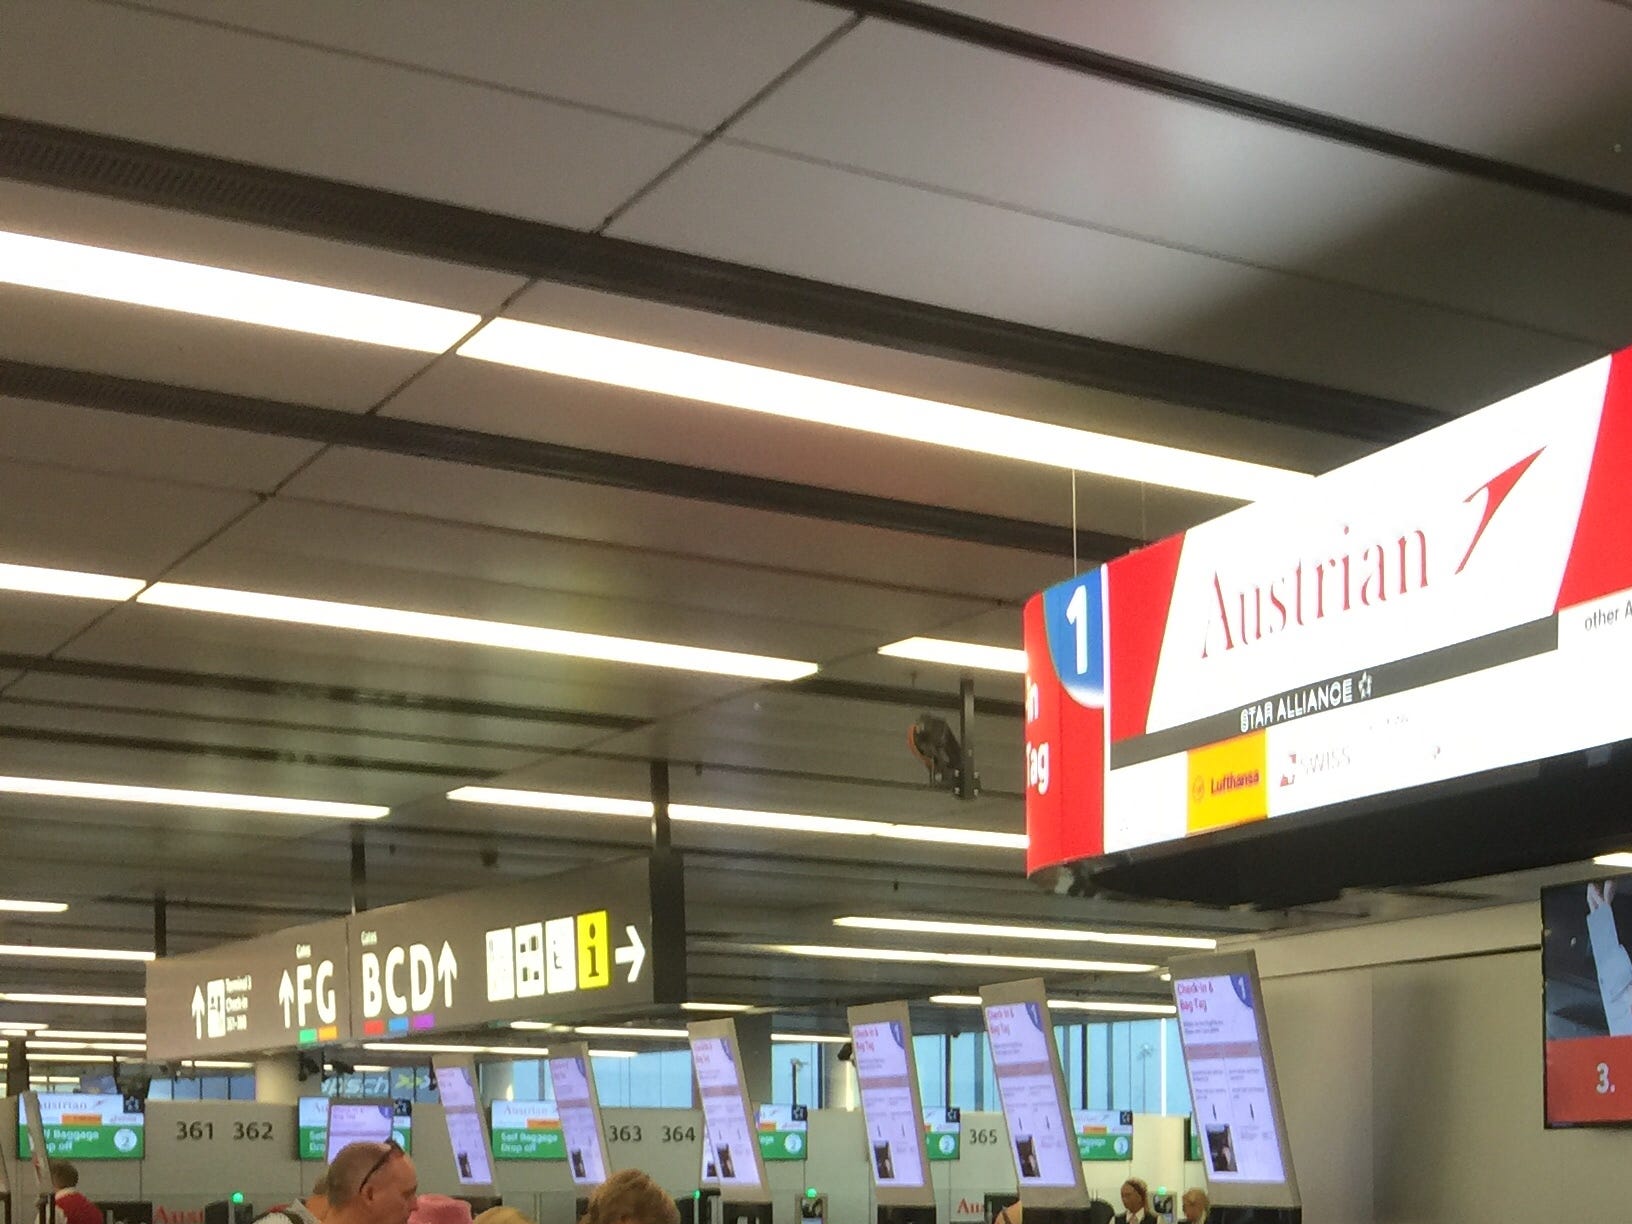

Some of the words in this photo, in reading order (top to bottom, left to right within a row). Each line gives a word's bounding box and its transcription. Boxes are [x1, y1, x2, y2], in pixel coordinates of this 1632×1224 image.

[1201, 522, 1429, 659] Austrian
[1066, 584, 1088, 675] 1
[1584, 608, 1620, 632] other
[1240, 699, 1273, 733] STAR
[1276, 677, 1353, 722] ALLIANCE
[1210, 769, 1260, 795] Lufthansa
[1596, 1062, 1616, 1094] 3.
[40, 1100, 88, 1111] ustrian
[176, 1120, 214, 1141] 361
[232, 1120, 274, 1141] 362
[608, 1124, 643, 1143] 363
[661, 1125, 697, 1143] 364
[969, 1128, 998, 1145] 365
